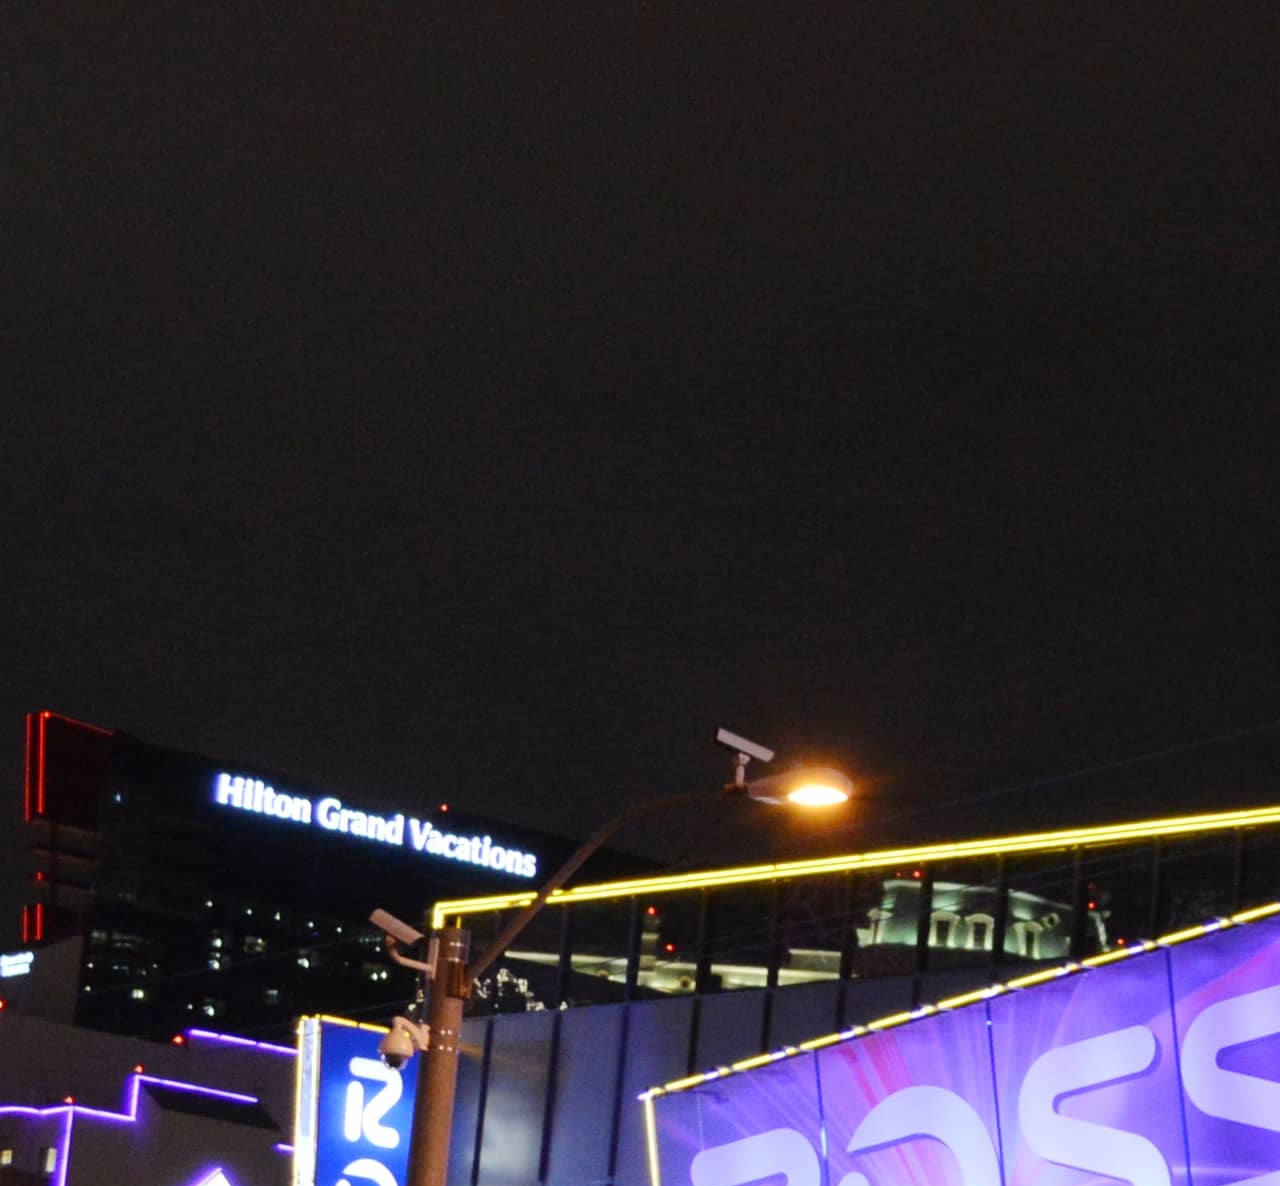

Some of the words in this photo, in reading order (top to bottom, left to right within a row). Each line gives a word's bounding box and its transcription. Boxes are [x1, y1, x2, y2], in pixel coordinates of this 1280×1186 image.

[217, 773, 311, 823] Hilton
[317, 798, 404, 846] Grand
[409, 818, 537, 878] Vacations
